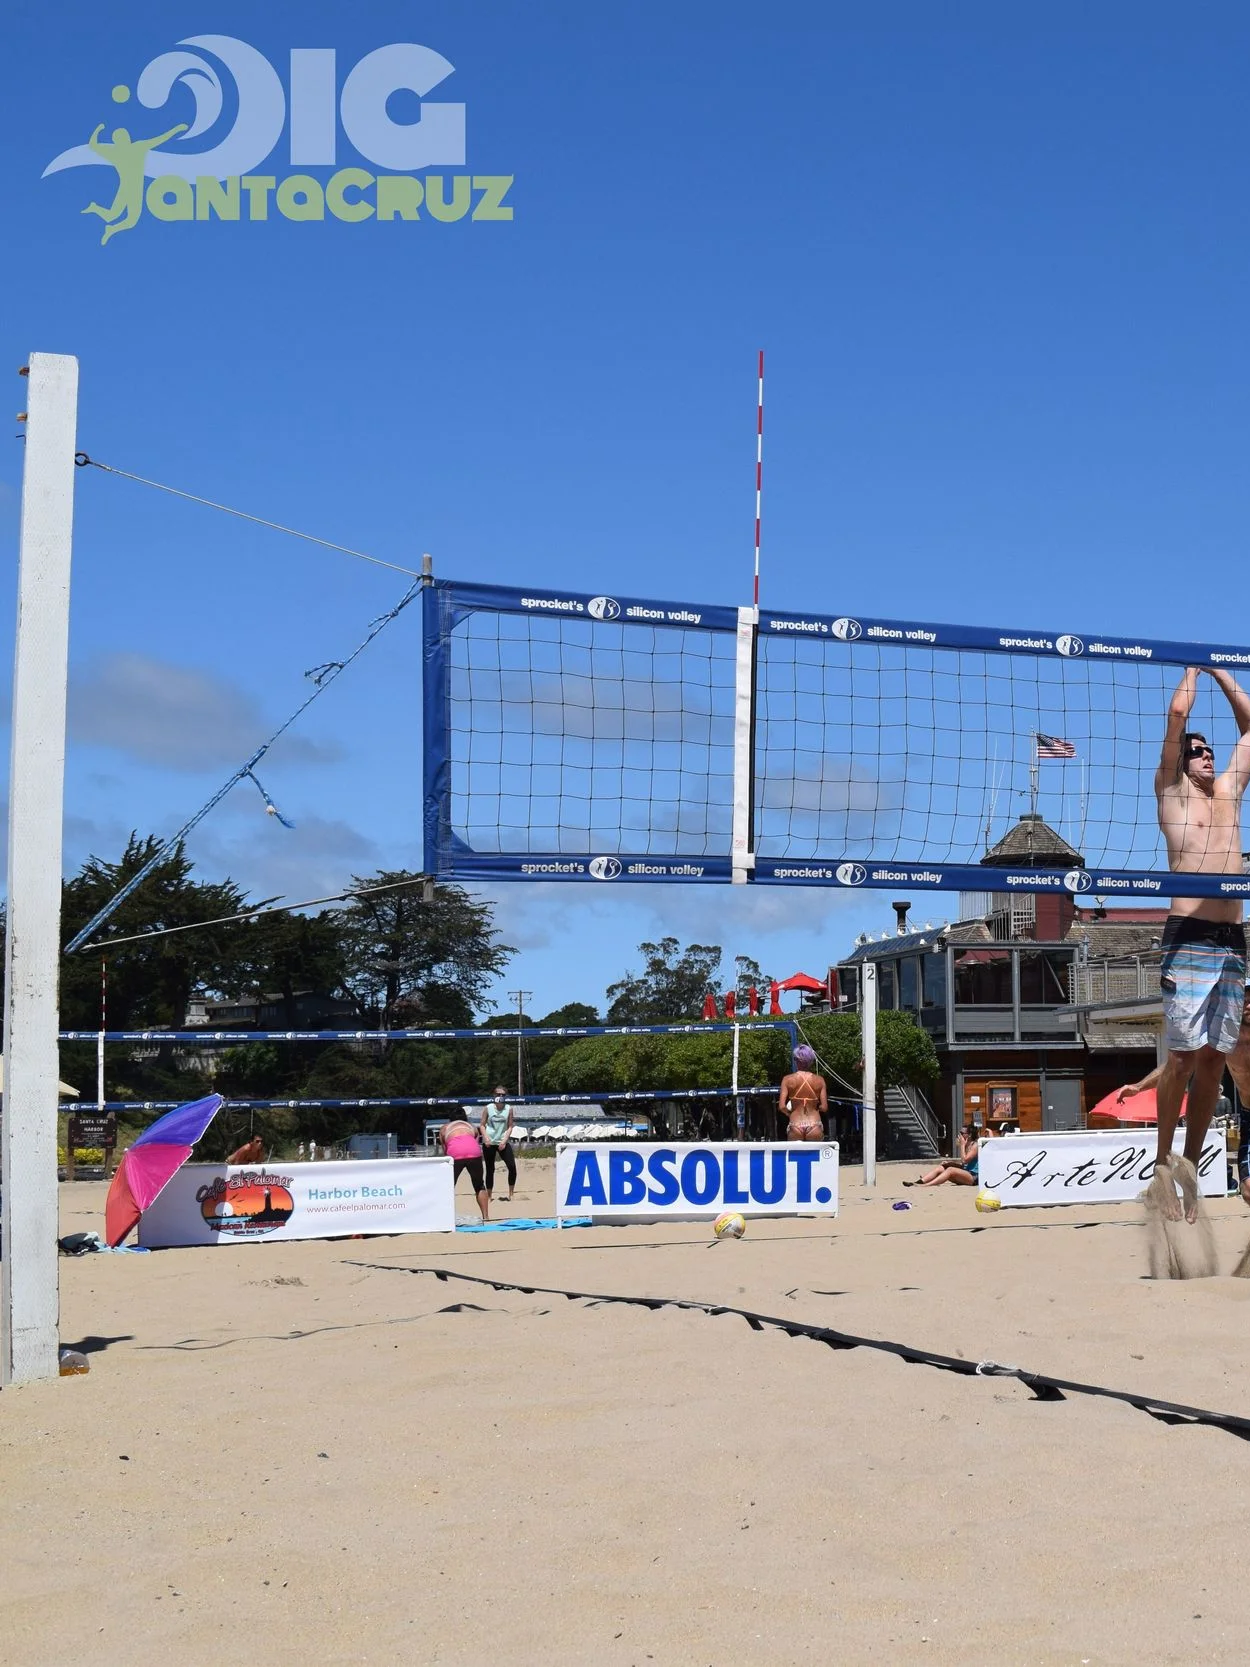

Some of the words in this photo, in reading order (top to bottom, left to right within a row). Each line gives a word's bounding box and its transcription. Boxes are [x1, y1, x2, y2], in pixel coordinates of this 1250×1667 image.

[521, 598, 583, 611] sprocket's
[627, 607, 664, 618] silicon
[668, 611, 701, 623] volley
[771, 621, 828, 632] sprocket's
[868, 627, 902, 638] silicon
[905, 630, 936, 642] volley
[1000, 638, 1052, 648] sprocket's
[1089, 644, 1121, 654] silicon
[1124, 646, 1152, 657] volley
[520, 862, 584, 874] sprocket's
[628, 864, 666, 874] silicon
[670, 865, 704, 877] volley
[774, 868, 832, 878] sprocket's
[872, 870, 907, 880] silicon
[911, 872, 942, 883] volley
[1007, 875, 1060, 885] sprocket's
[1097, 878, 1129, 887] silicon
[1133, 879, 1161, 890] volley
[866, 968, 875, 980] 2
[308, 1187, 358, 1200] Harbor
[361, 1184, 403, 1198] Beach
[306, 1202, 406, 1213] www.cafeelpalomar.com
